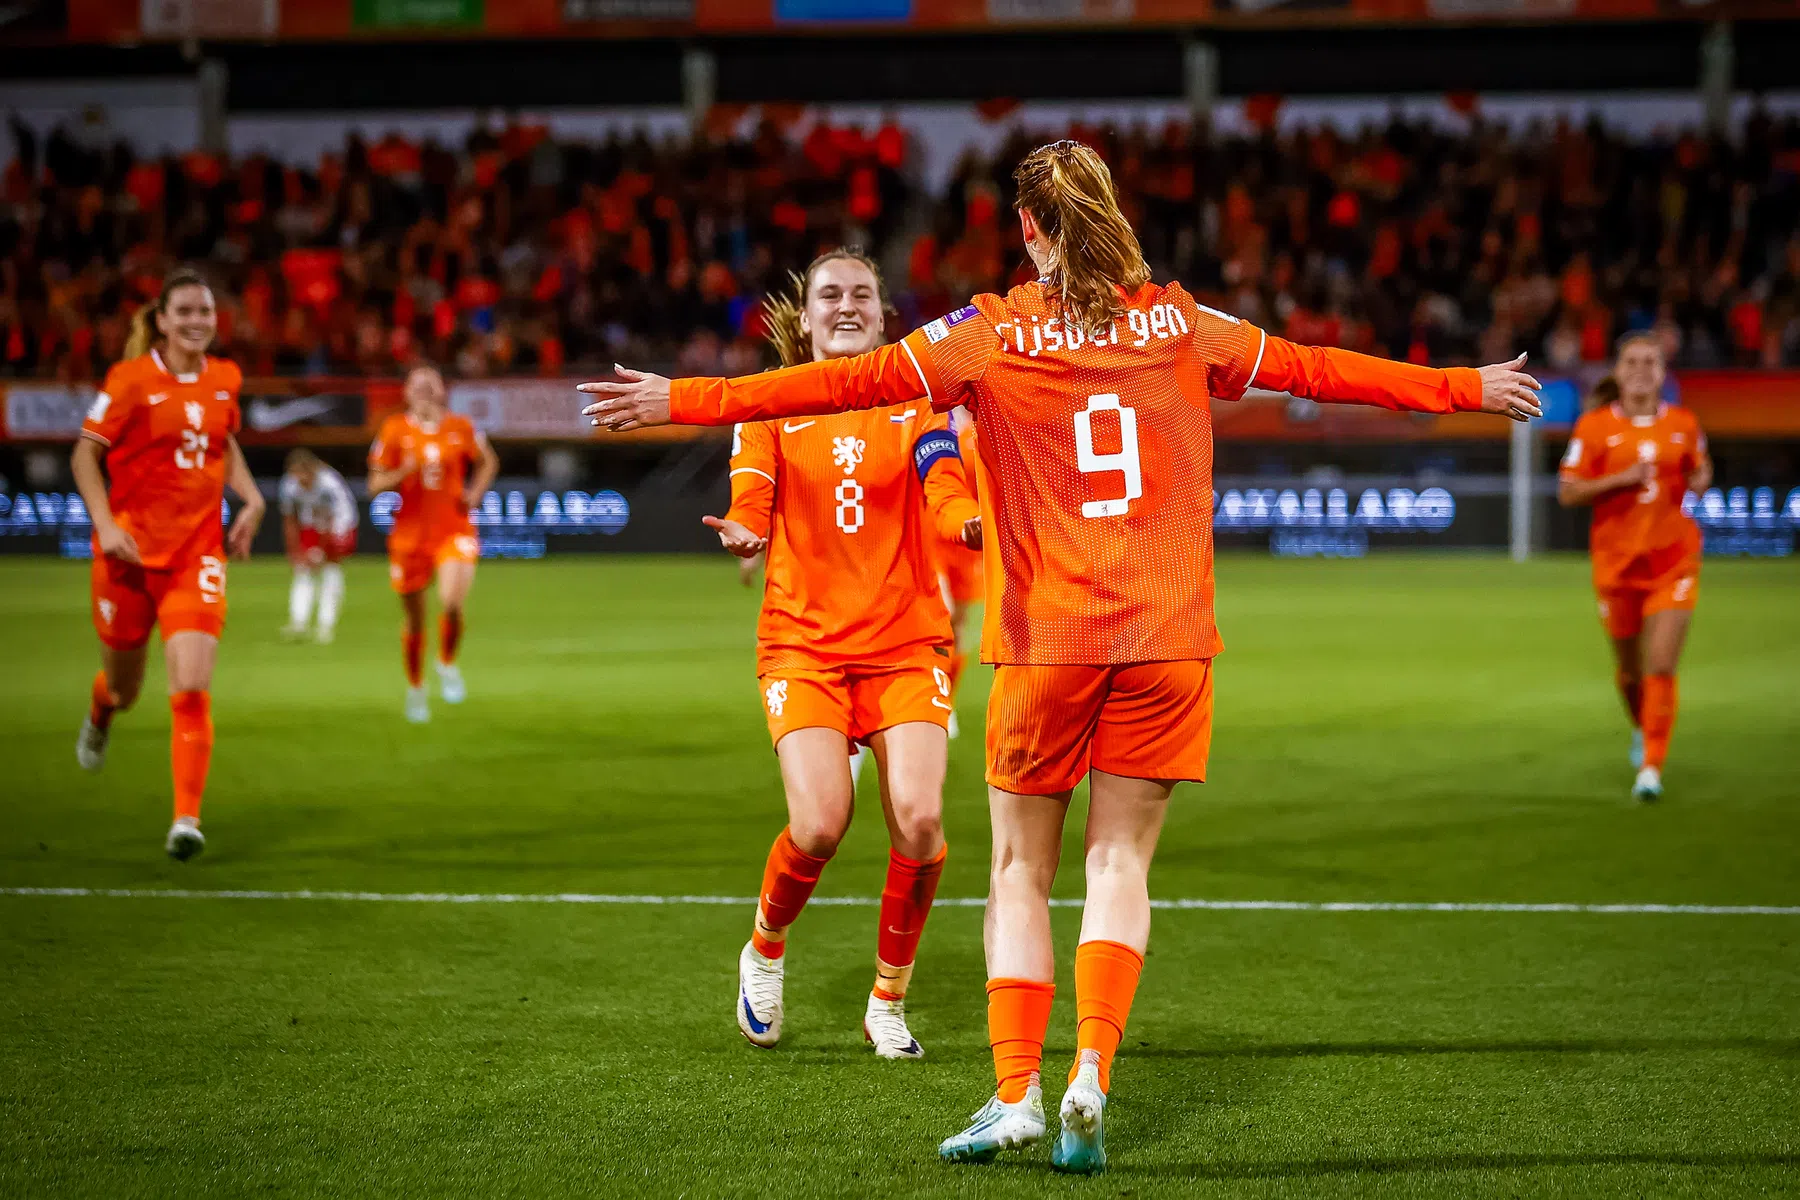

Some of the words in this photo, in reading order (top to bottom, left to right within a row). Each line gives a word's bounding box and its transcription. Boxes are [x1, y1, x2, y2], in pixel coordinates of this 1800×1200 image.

[174, 429, 209, 469] 21
[1073, 393, 1143, 519] 9
[835, 479, 864, 533] 8
